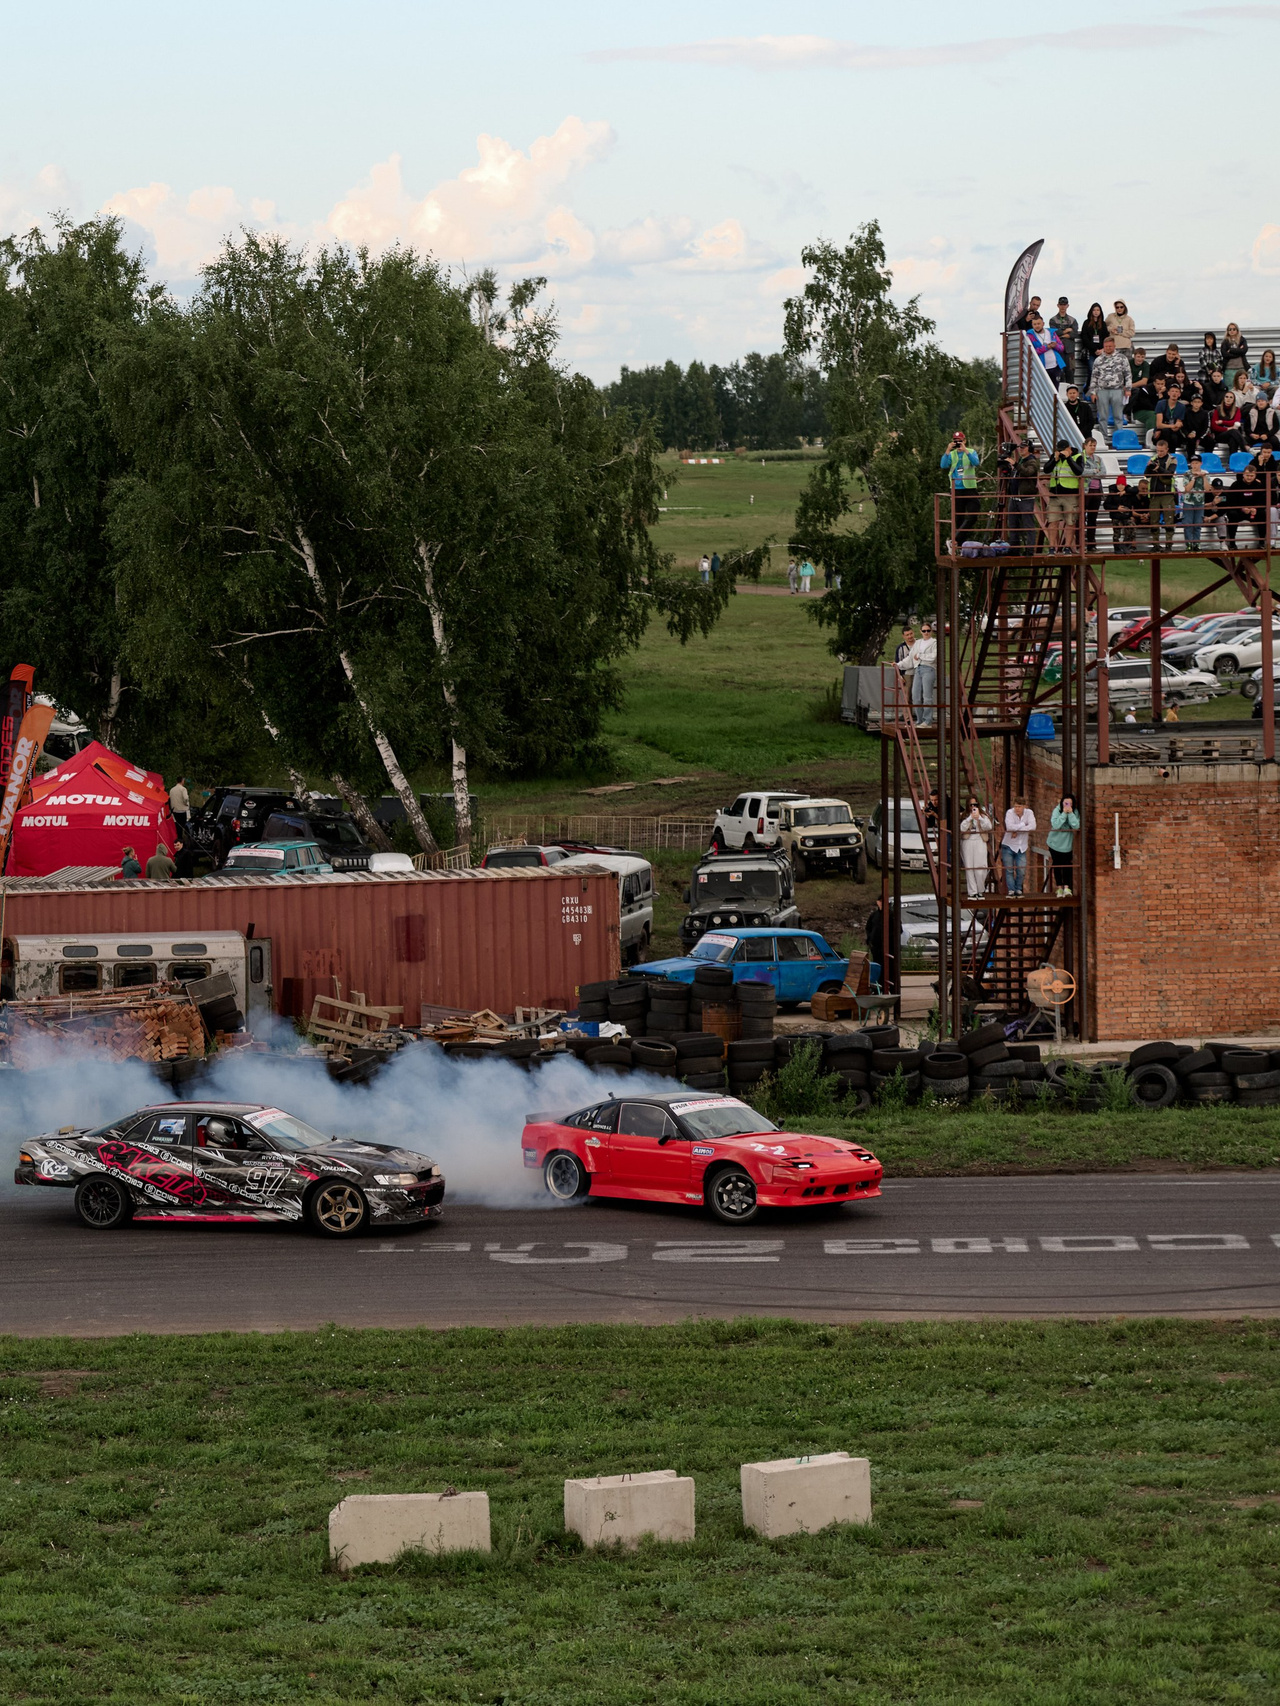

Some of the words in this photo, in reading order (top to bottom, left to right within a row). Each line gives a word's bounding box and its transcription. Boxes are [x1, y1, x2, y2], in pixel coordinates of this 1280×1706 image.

[0, 715, 14, 787] AODES
[46, 794, 123, 806] MOTUL
[21, 815, 69, 827] MOTUL
[103, 815, 150, 827] MOTUL
[138, 1141, 160, 1155] СОЮЗ
[170, 1157, 193, 1171] СОЮЗ
[750, 1143, 788, 1156] 22
[55, 1142, 76, 1158] СОЮЗ
[86, 1157, 106, 1172] СОЮЗ
[120, 1173, 143, 1188] СОЮЗ
[156, 1188, 179, 1203] СОЮЗ
[97, 1140, 207, 1205] РАКЕТА
[245, 1167, 291, 1196] 97
